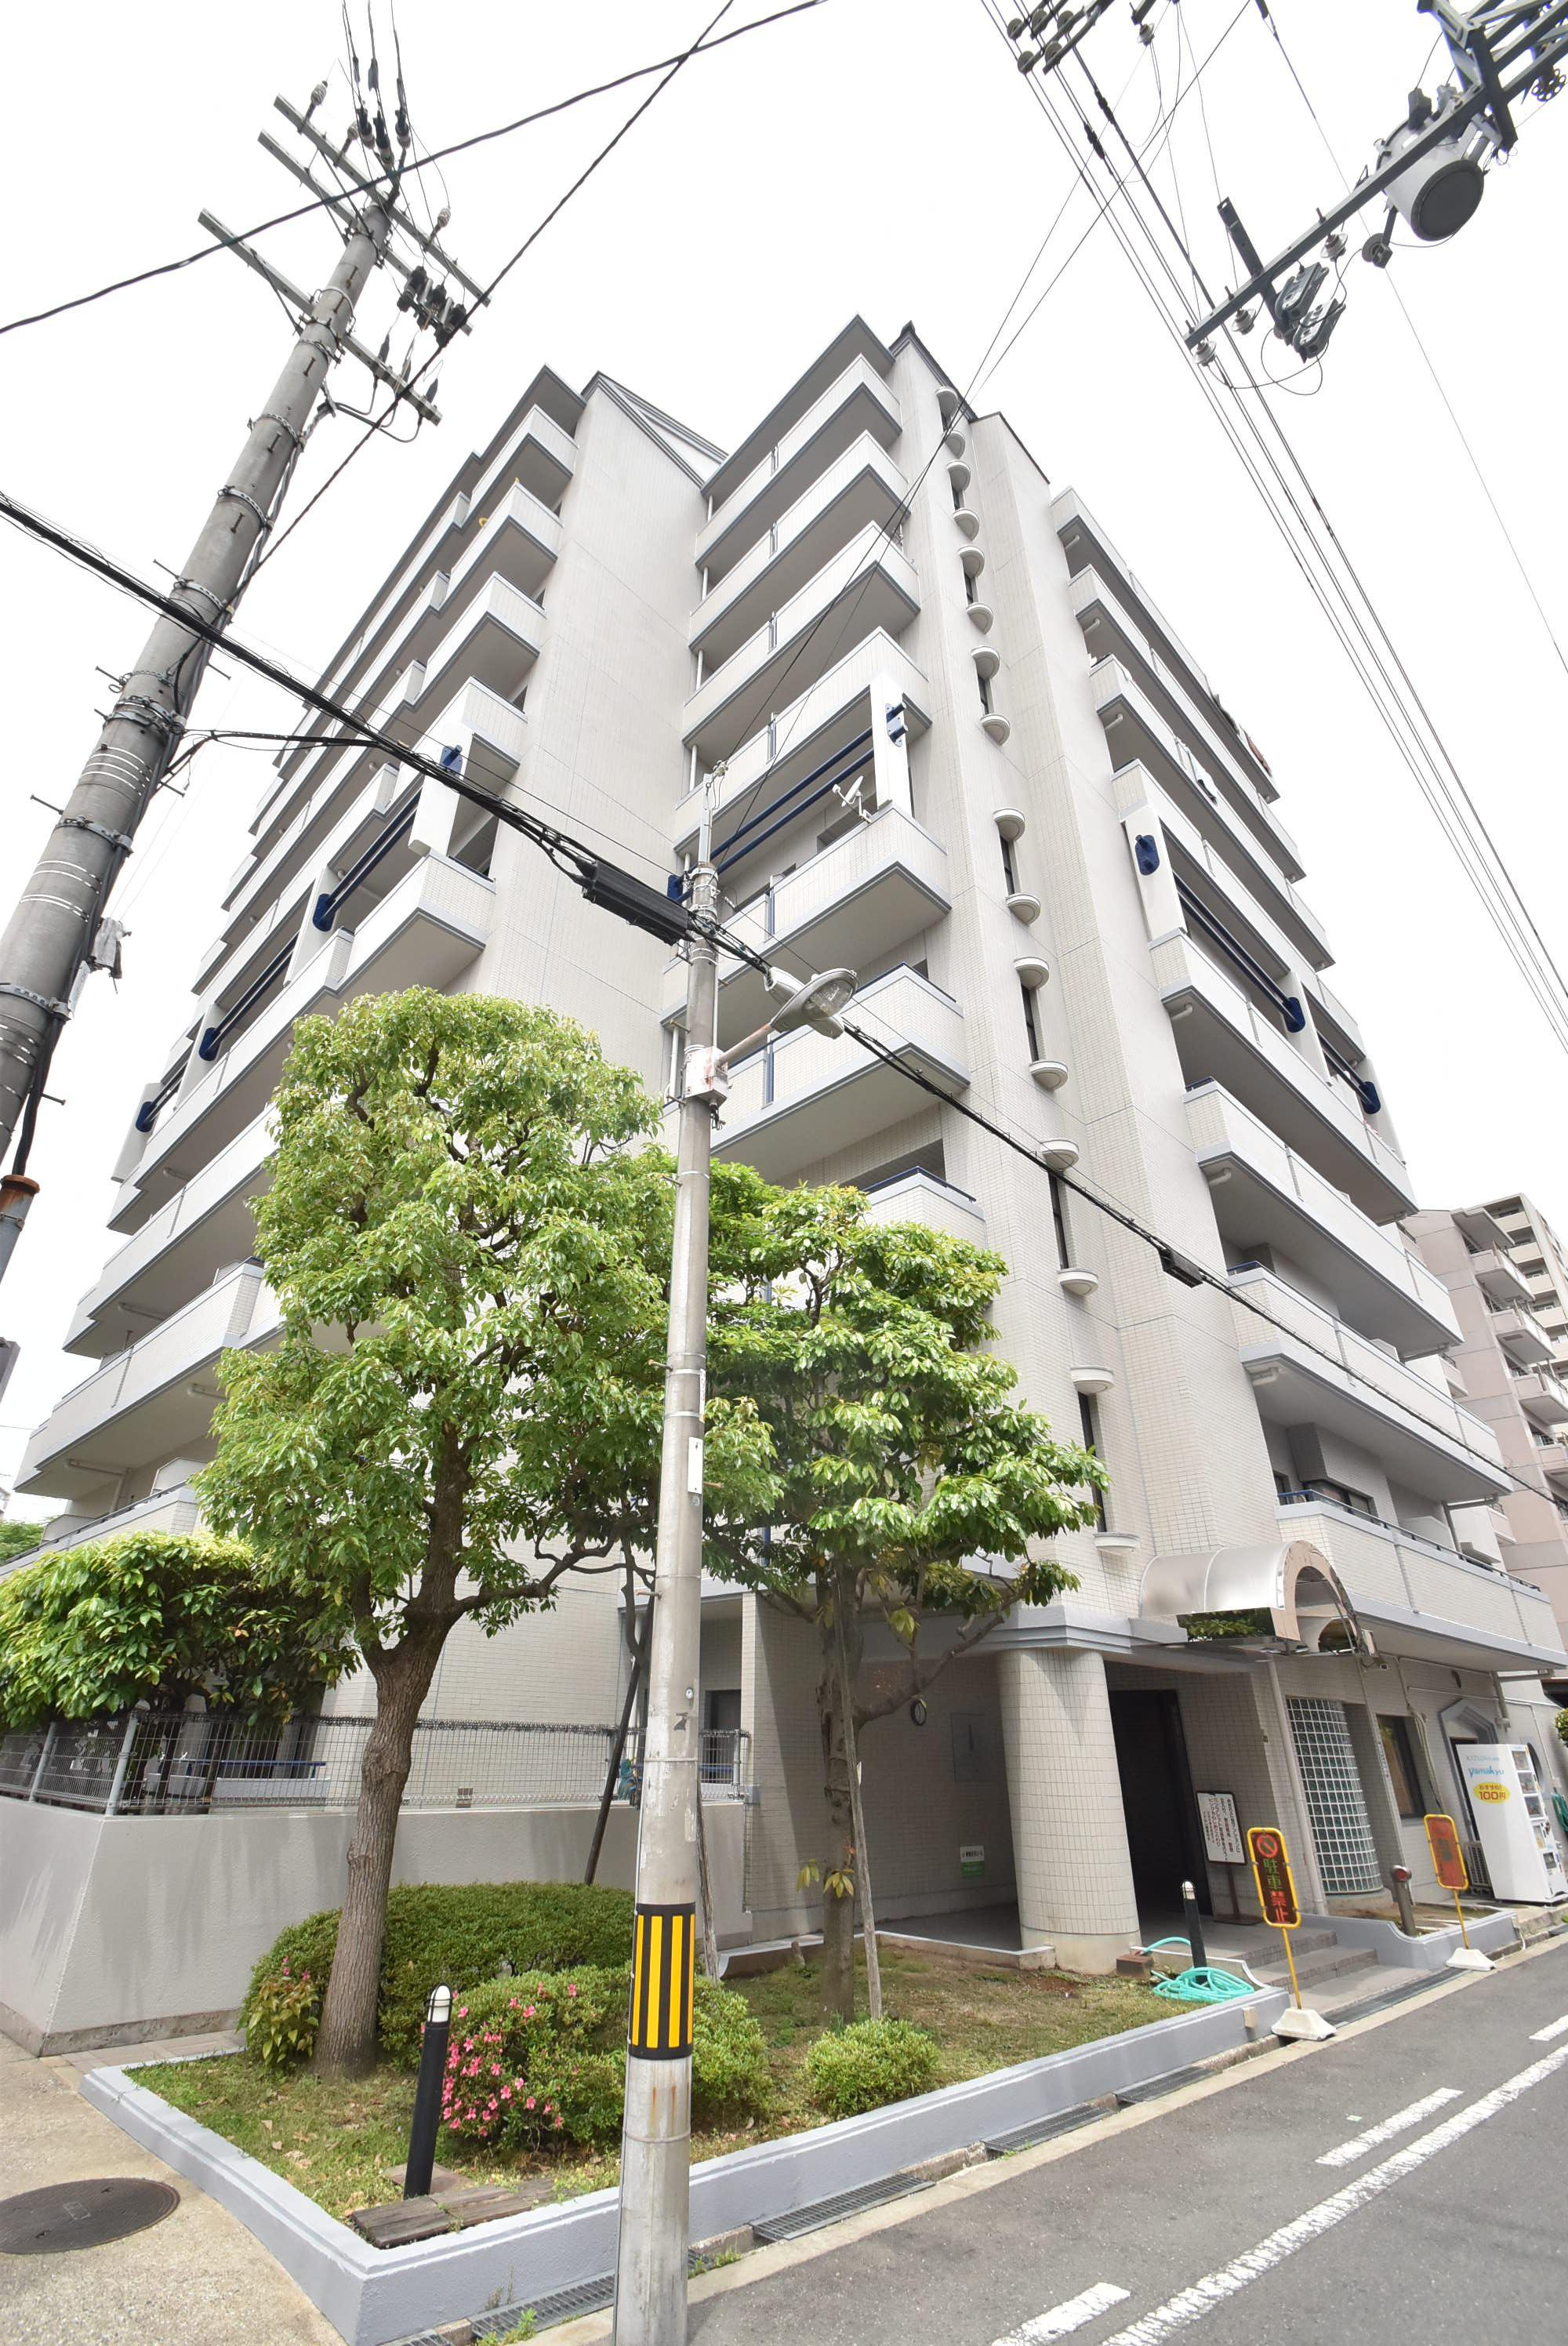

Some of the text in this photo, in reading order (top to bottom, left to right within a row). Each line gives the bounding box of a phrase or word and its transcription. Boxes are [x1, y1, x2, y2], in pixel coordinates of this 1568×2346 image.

[1479, 1791, 1506, 1800] 100円
[1263, 1858, 1288, 1922] 駐車禁止
